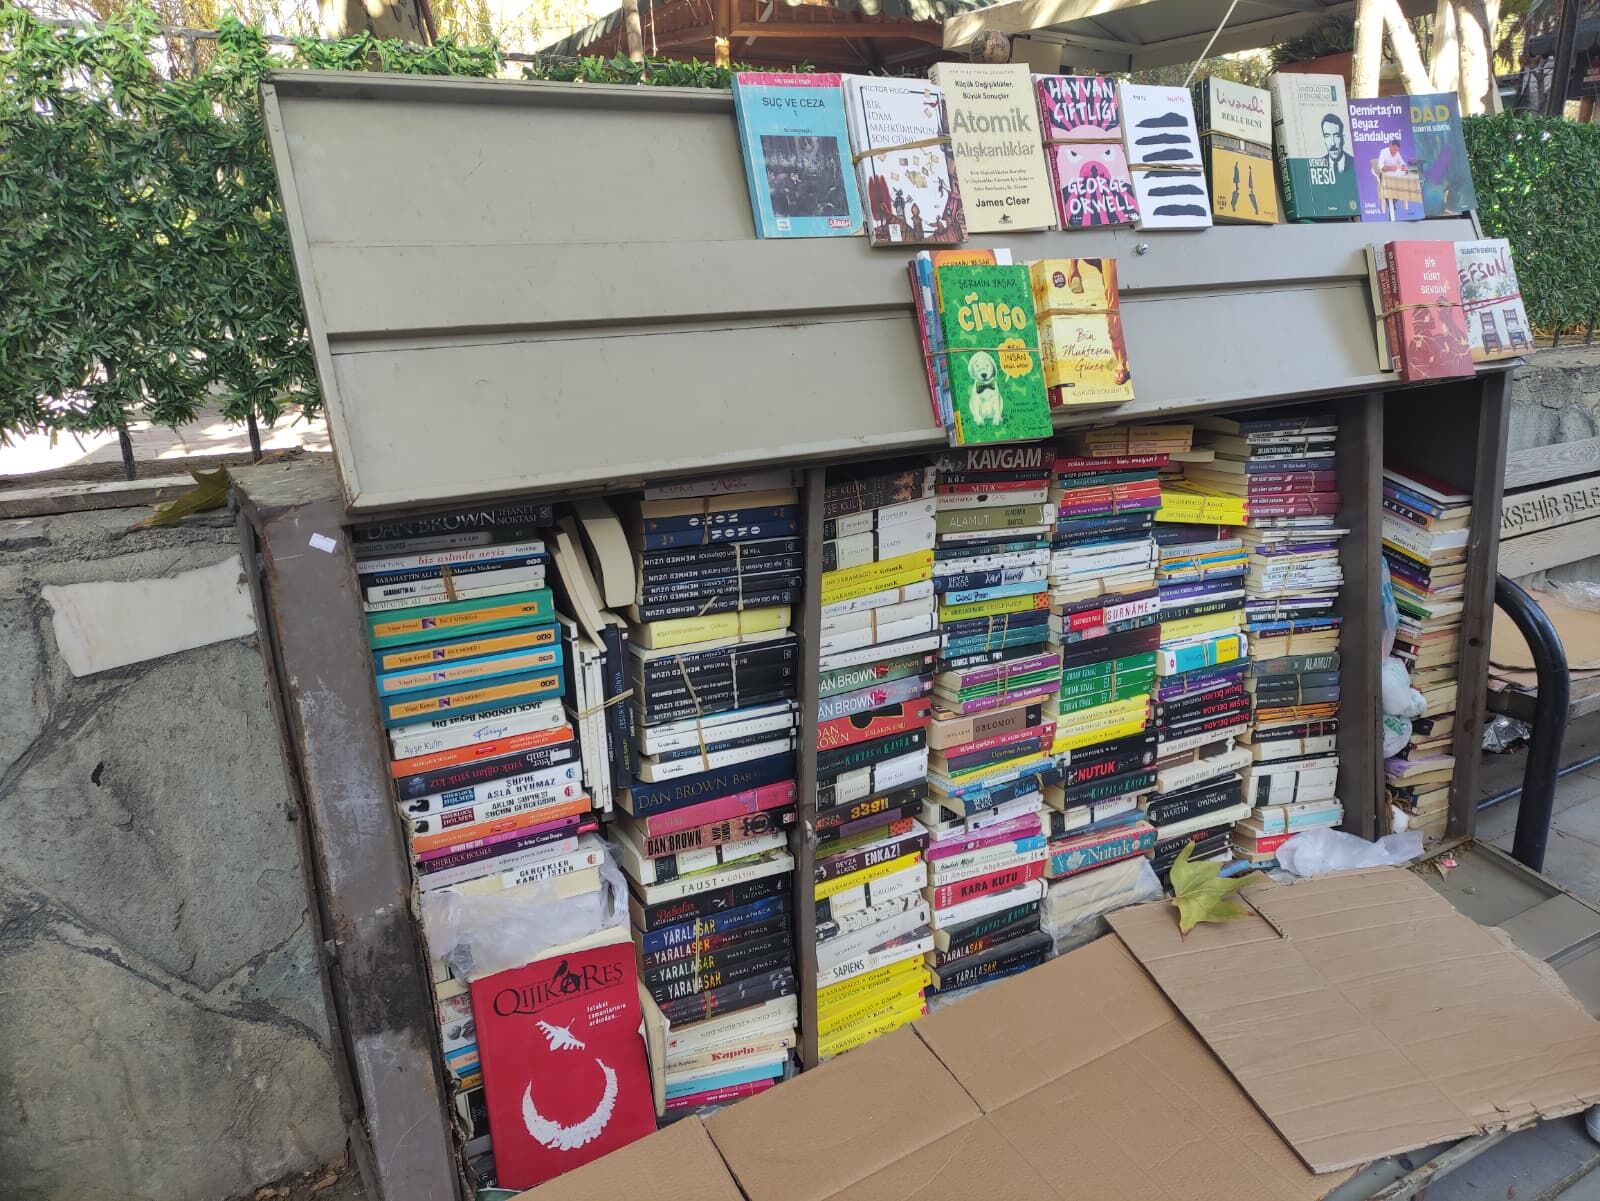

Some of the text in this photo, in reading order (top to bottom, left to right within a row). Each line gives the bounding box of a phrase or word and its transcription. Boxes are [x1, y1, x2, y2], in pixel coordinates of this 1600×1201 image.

[1049, 79, 1114, 100] HAYVAN
[763, 97, 824, 109] SUÇ VE CEZA
[983, 93, 1009, 101] Sonuçlar
[1350, 105, 1402, 118] Demirtaş'ın
[1411, 106, 1449, 123] DAD
[952, 108, 1032, 134] Atomik
[1352, 119, 1379, 129] Beyaz
[872, 134, 890, 142] SON
[1354, 132, 1401, 143] Sandalyesi
[956, 141, 1035, 160] Alışkanlıklar
[1066, 176, 1127, 193] GEORGE
[976, 196, 1030, 208] James Clear
[1070, 195, 1135, 216] ORWELL
[1457, 247, 1507, 287] EFSUN
[967, 448, 1041, 469] KAVGAM
[419, 511, 496, 534] BROWN
[950, 515, 989, 527] ALAMUT
[644, 554, 695, 565] MEHMED UZUN
[670, 571, 698, 579] MEHMED
[671, 583, 698, 591] MEHMED
[670, 591, 698, 599] MEHMED
[666, 605, 695, 614] MEHMED
[1305, 657, 1332, 671] ALAMUT
[651, 666, 700, 679] MEHED UZUN
[819, 668, 877, 692] AN BROWN
[518, 702, 542, 712] JACK
[654, 697, 702, 710] MHMED UZUN
[835, 694, 876, 714] BROWN
[451, 714, 476, 724] Beyaz
[479, 707, 518, 720] LONDON
[975, 717, 1016, 733] OBLOMOV
[424, 740, 443, 750] Kulin
[1078, 761, 1116, 781] NUTUK
[487, 789, 512, 799] ASLA
[638, 792, 671, 810] DAN
[675, 776, 728, 800] BROWN
[1163, 805, 1188, 818] MARTIN
[648, 830, 702, 856] DAN BROWN
[1087, 840, 1130, 862] Nutuk
[682, 878, 717, 894] FAUST
[961, 872, 1018, 896] KARA KUTU
[724, 916, 743, 925] MARAL
[746, 908, 771, 918] ATMACA
[744, 927, 768, 936] ATMACA
[749, 943, 772, 953] ATMACA
[942, 940, 984, 963] YARALASAR
[730, 968, 749, 977] MARAL
[752, 960, 777, 970] ATMACA
[833, 960, 865, 978] SAPIENS
[956, 961, 997, 983] YARALASAR
